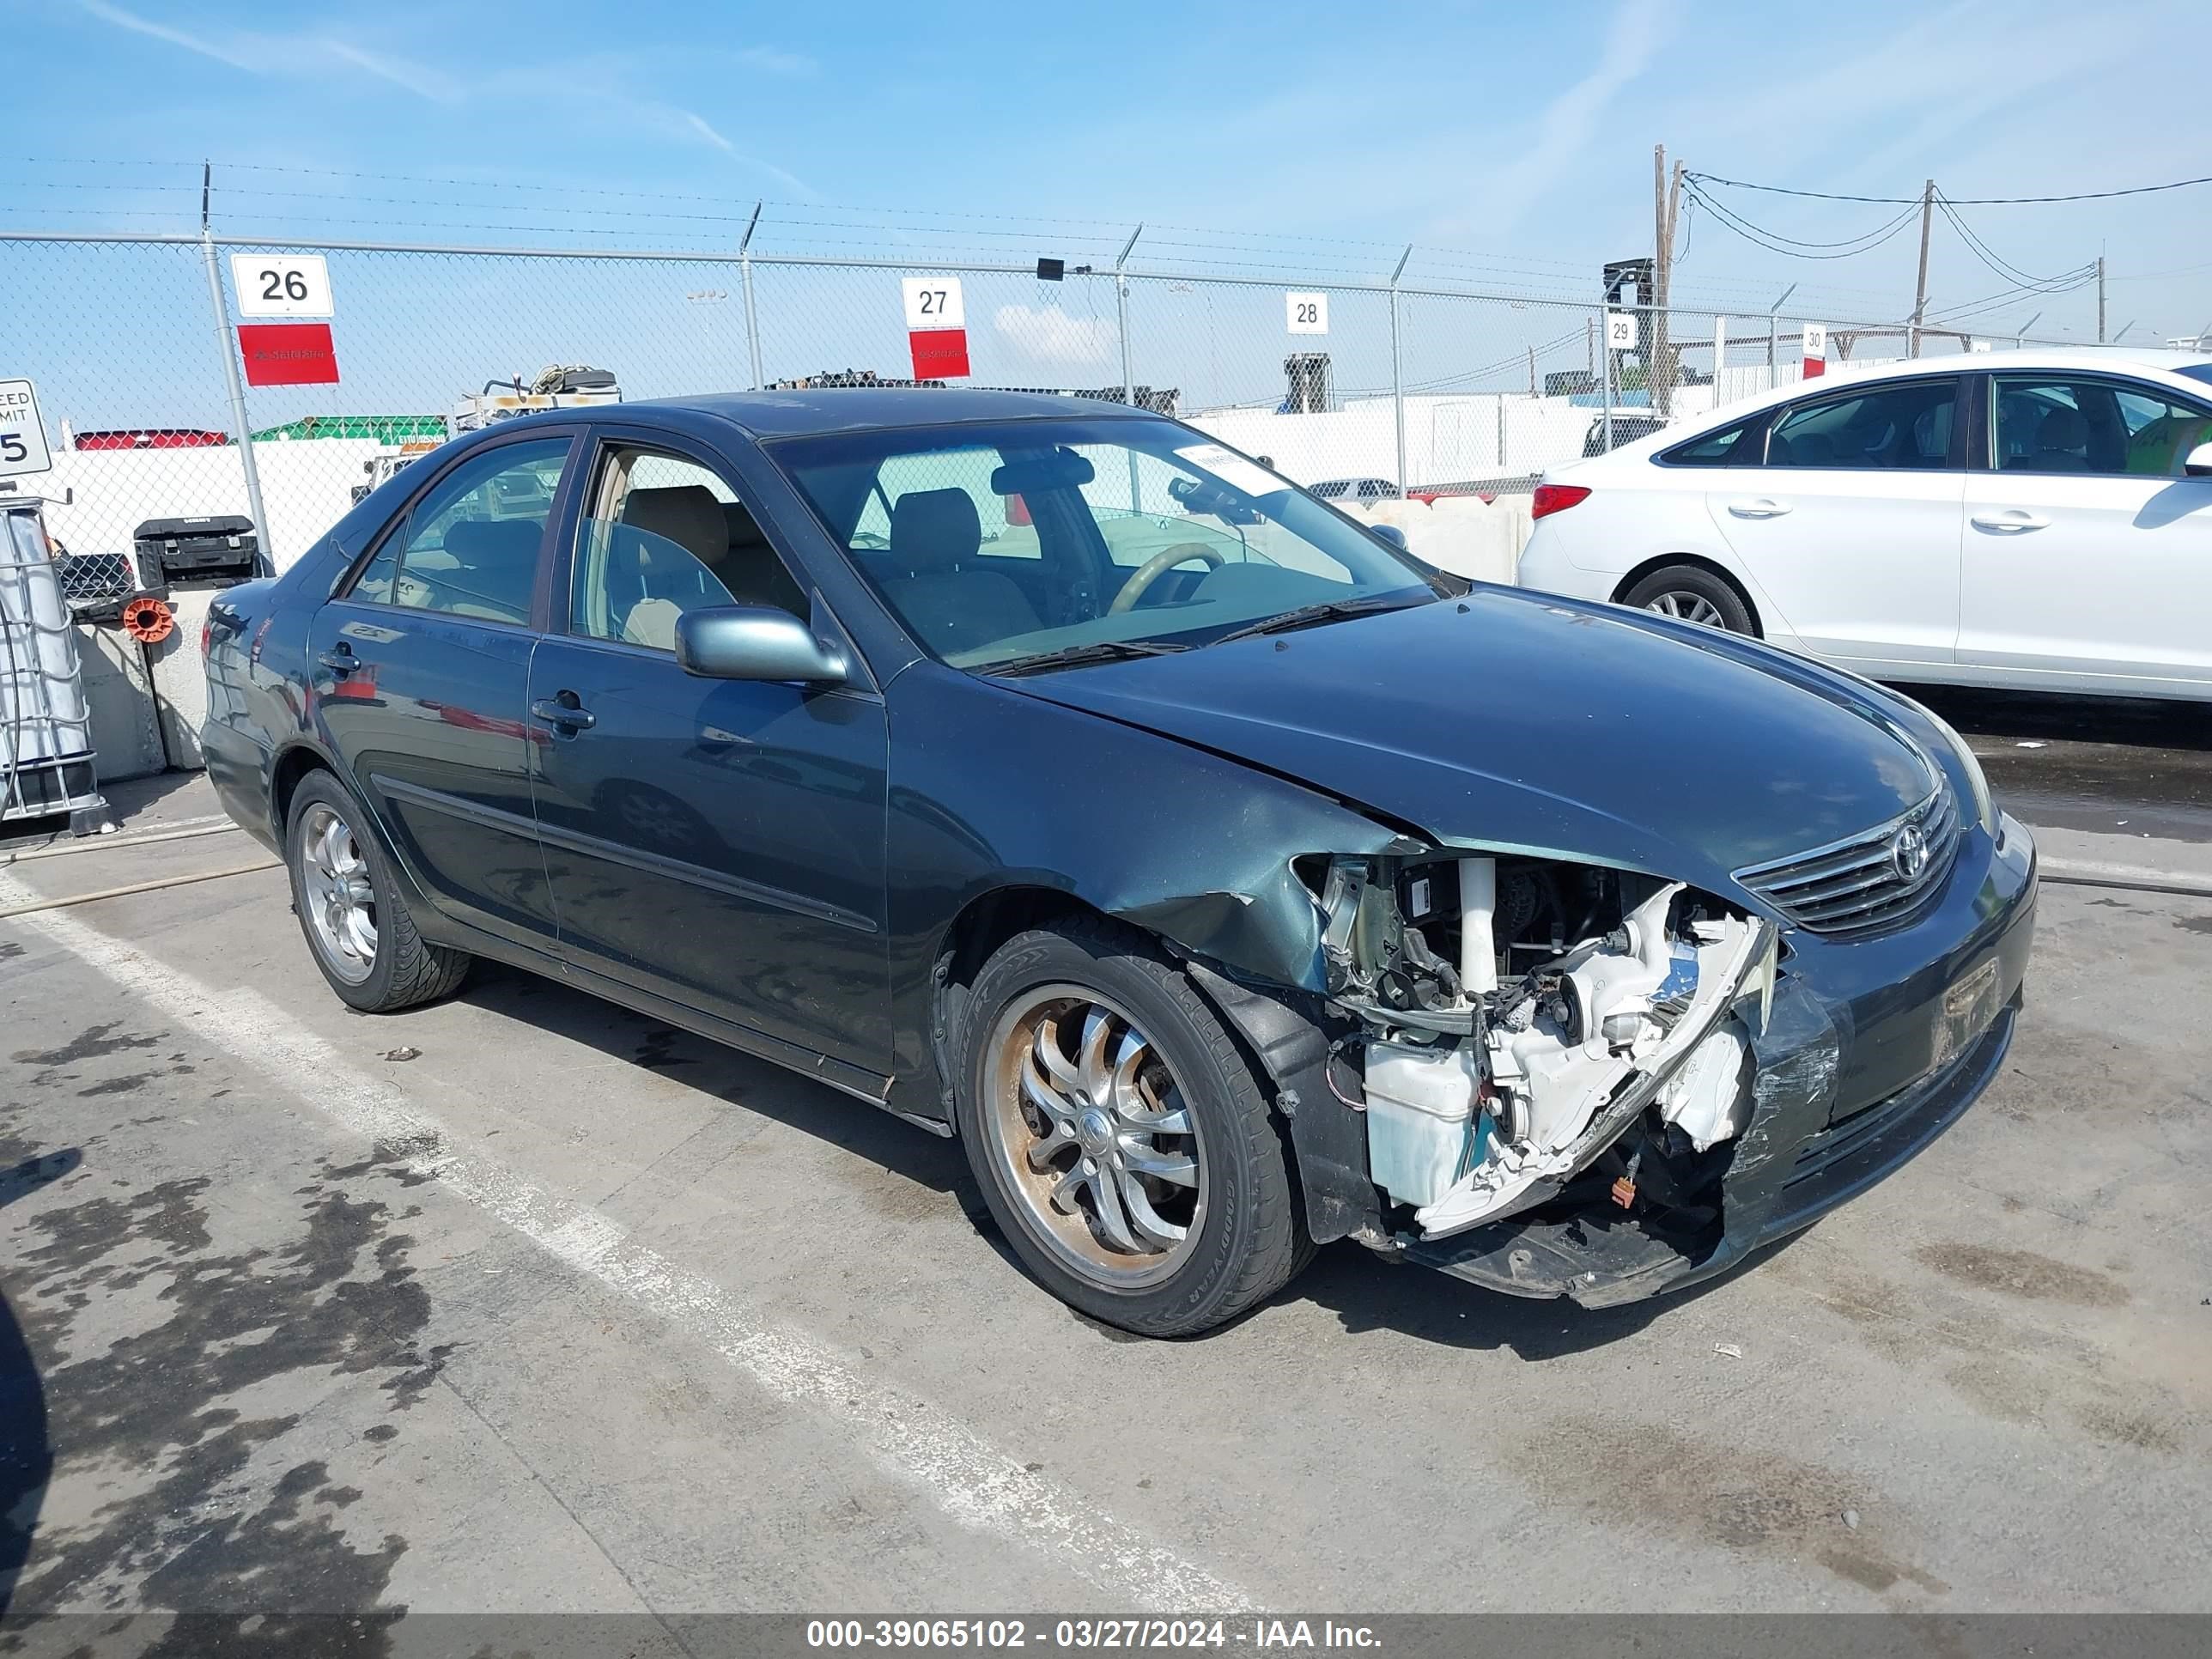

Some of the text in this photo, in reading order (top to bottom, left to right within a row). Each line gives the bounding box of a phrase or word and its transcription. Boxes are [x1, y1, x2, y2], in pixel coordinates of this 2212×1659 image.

[259, 270, 308, 301] 26
[920, 290, 947, 314] 27
[1297, 303, 1317, 323] 28
[1613, 323, 1628, 340] 29
[1809, 332, 1820, 348] 30
[0, 433, 27, 462] 5
[1188, 1179, 1236, 1304] GOODYEAR
